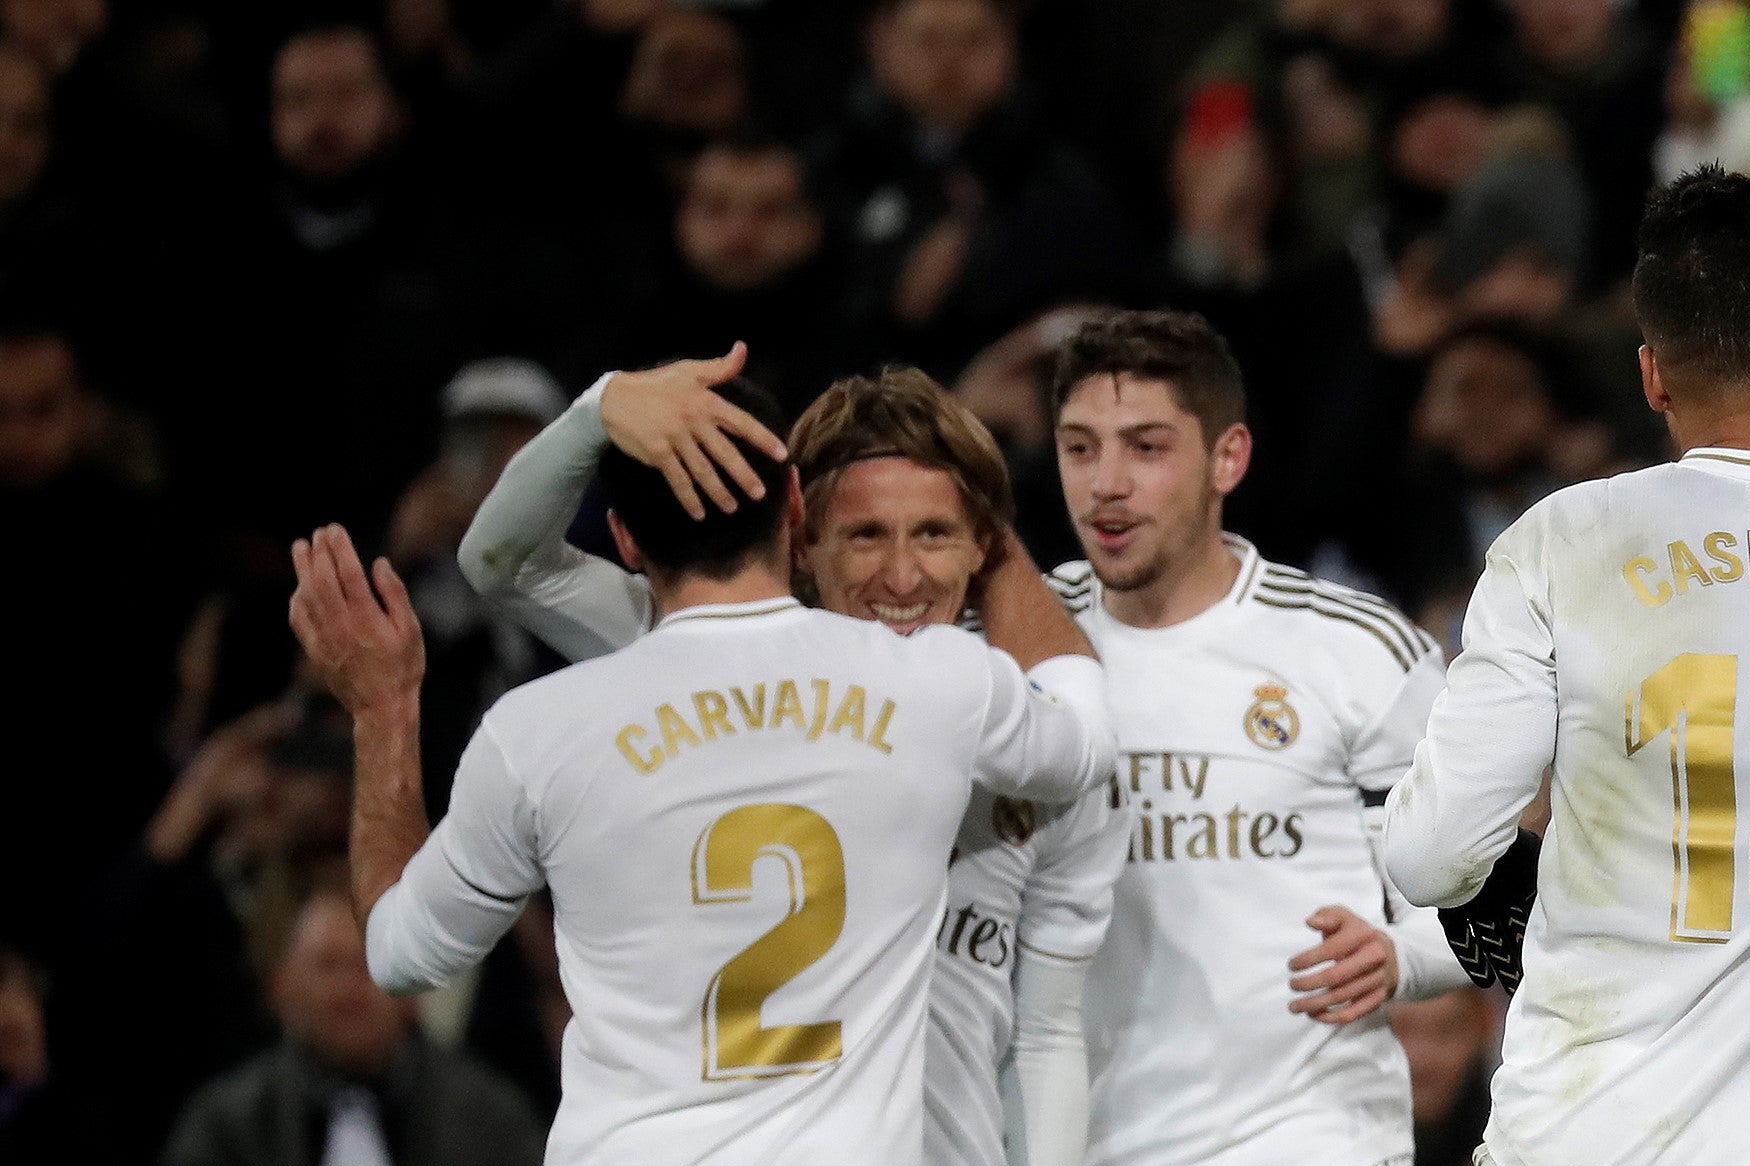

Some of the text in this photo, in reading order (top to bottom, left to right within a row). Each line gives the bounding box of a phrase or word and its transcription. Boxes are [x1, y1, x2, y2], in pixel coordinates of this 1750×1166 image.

[615, 677, 898, 776] CARVAJAL
[1127, 753, 1210, 798] Fly
[1128, 803, 1304, 862] irates
[690, 803, 847, 1082] 2
